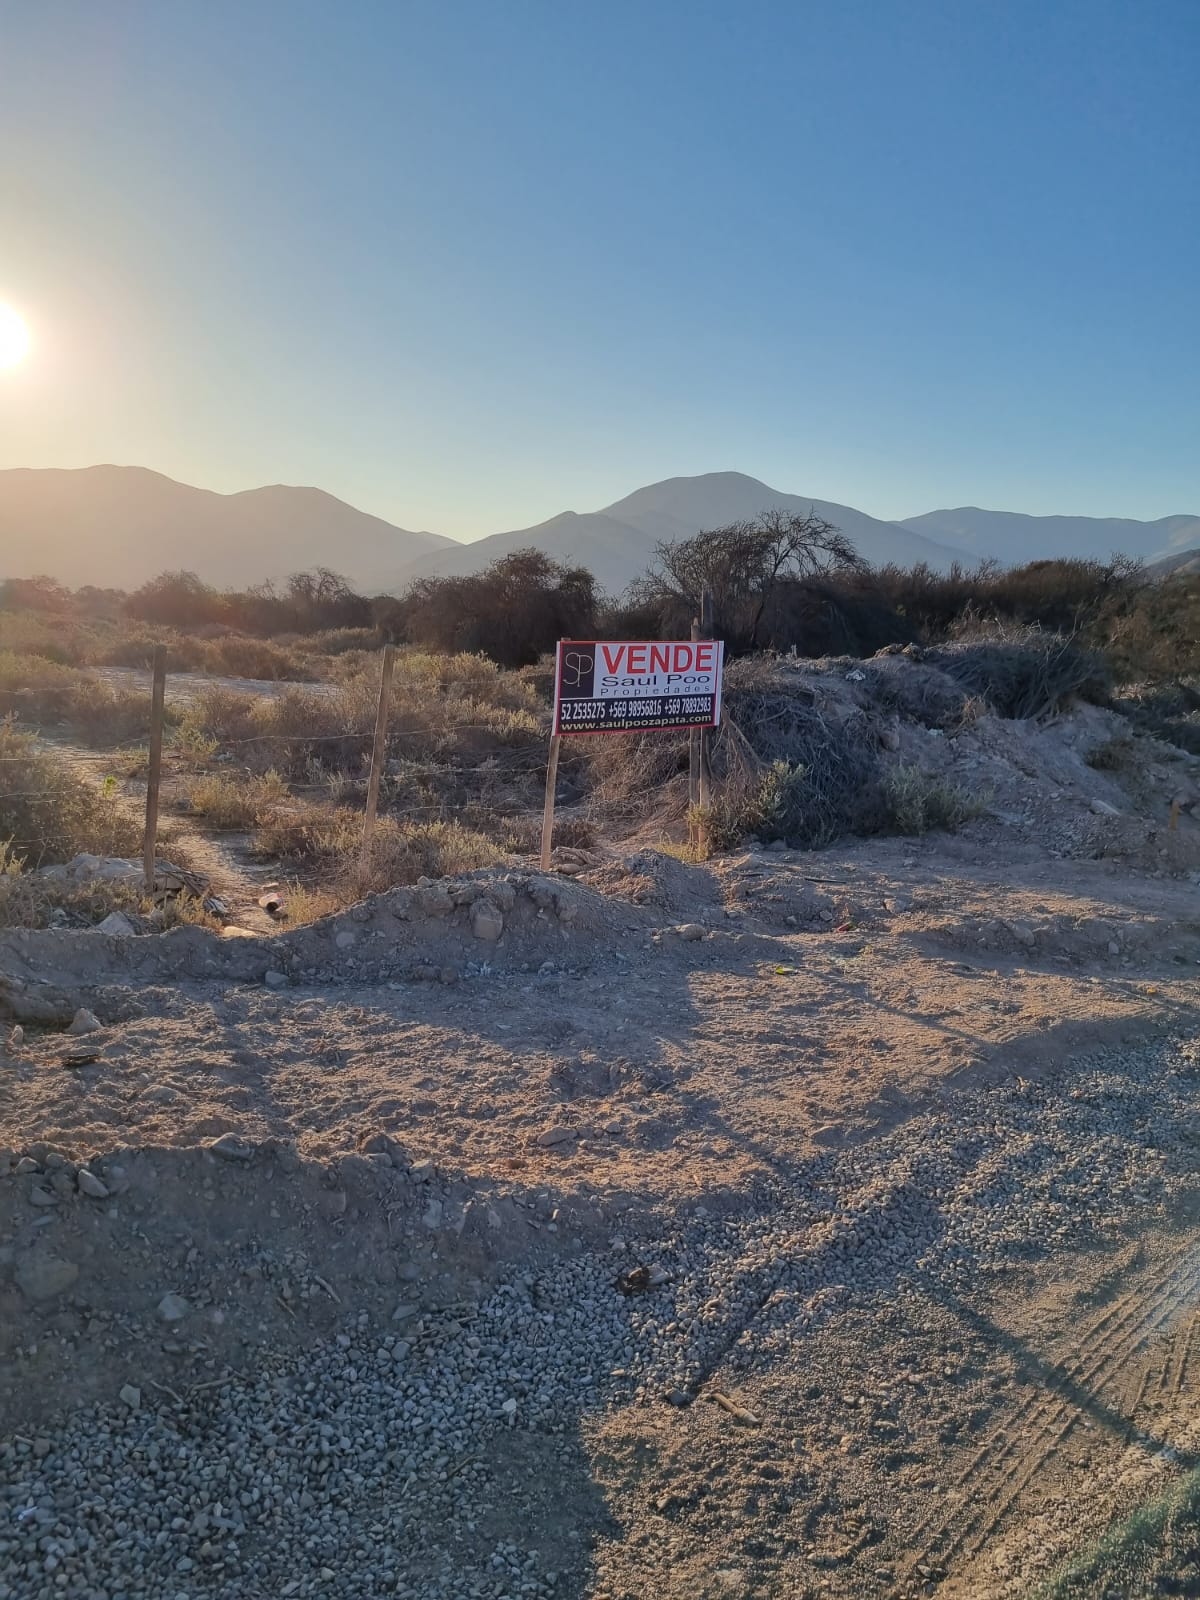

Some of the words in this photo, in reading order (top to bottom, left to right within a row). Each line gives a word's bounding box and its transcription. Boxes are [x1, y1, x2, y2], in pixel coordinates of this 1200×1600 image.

[601, 645, 712, 674] VENDE
[601, 675, 657, 687] Saul
[667, 674, 710, 685] Poo
[600, 686, 710, 697] Propiedades
[561, 703, 572, 720] 52
[572, 701, 606, 719] 2535275
[609, 700, 627, 718] +569
[628, 699, 661, 717] 98956816
[664, 698, 682, 715] +569
[561, 714, 712, 730] www.saulpoozapata.com
